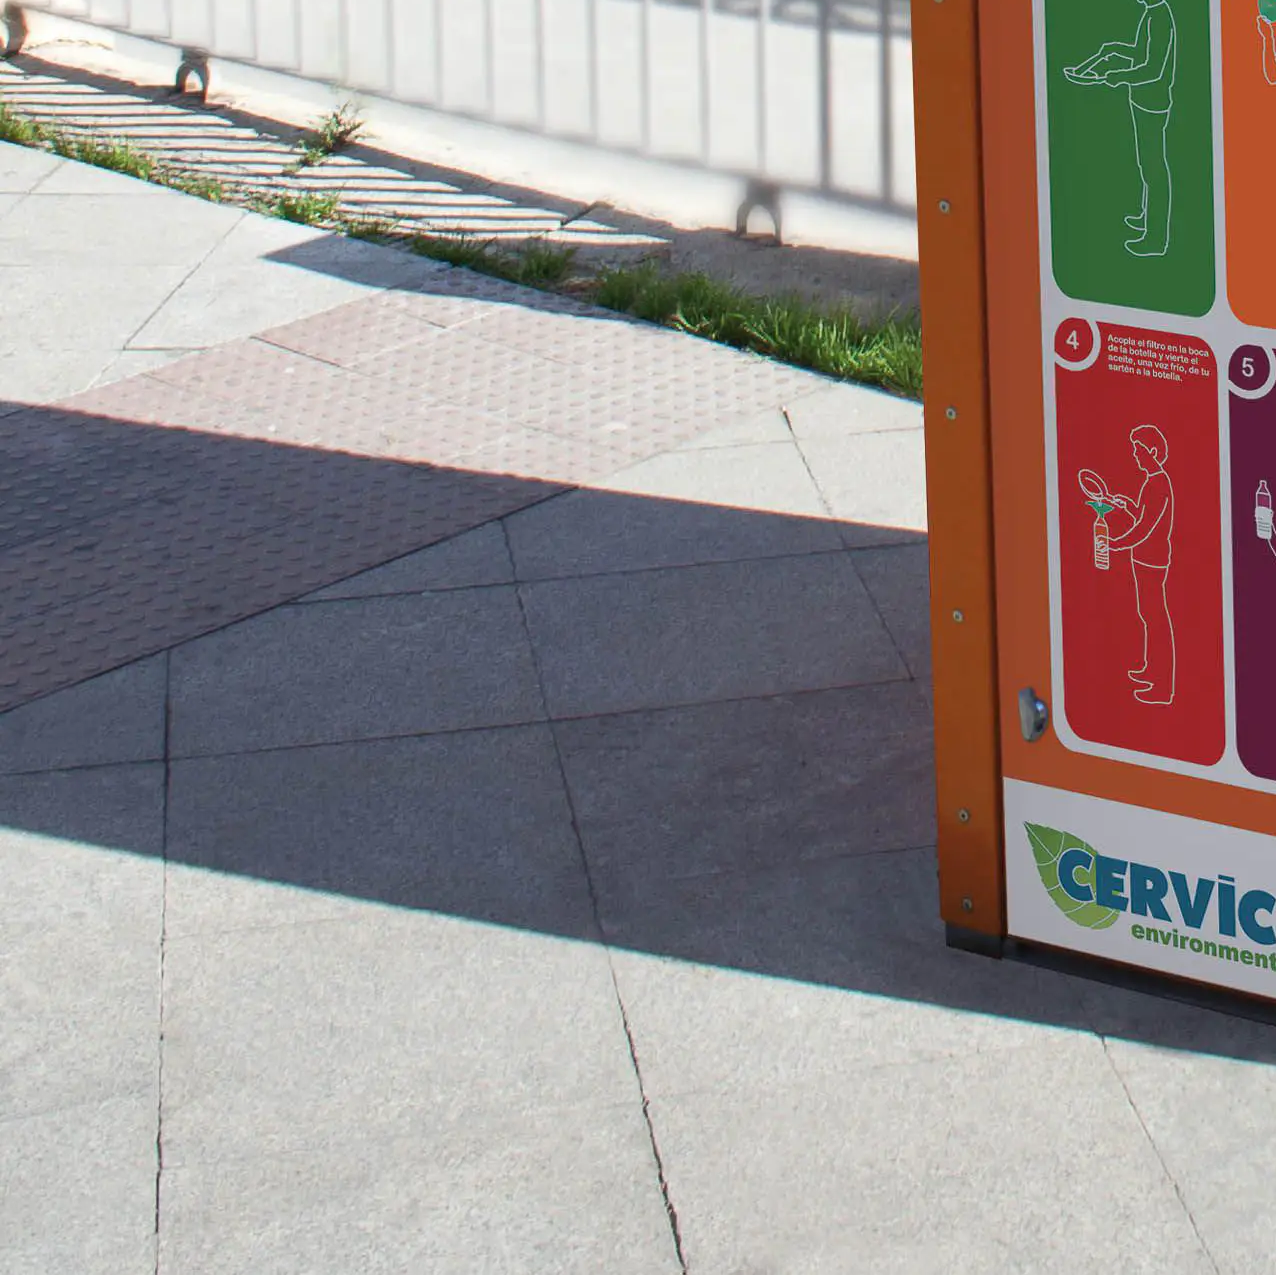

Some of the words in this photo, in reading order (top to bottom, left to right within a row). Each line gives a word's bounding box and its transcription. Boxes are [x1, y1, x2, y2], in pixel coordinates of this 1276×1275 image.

[1066, 330, 1079, 350] 4
[1108, 334, 1136, 346] Acopla
[1138, 339, 1145, 347] el
[1147, 340, 1166, 350] filtro
[1180, 345, 1187, 353] la
[1189, 347, 1209, 357] boca
[1108, 344, 1118, 352] de
[1120, 346, 1127, 354] la
[1129, 347, 1157, 358] botella
[1165, 353, 1189, 363] vierte
[1191, 356, 1198, 364] el
[1108, 354, 1136, 365] aceite,
[1138, 359, 1152, 367] una
[1154, 361, 1168, 369] vez
[1189, 366, 1199, 375] de
[1201, 368, 1209, 376] tu
[1109, 363, 1134, 374] sartén
[1143, 368, 1150, 376] la
[1152, 369, 1182, 381] botella.
[1242, 357, 1254, 377] 5
